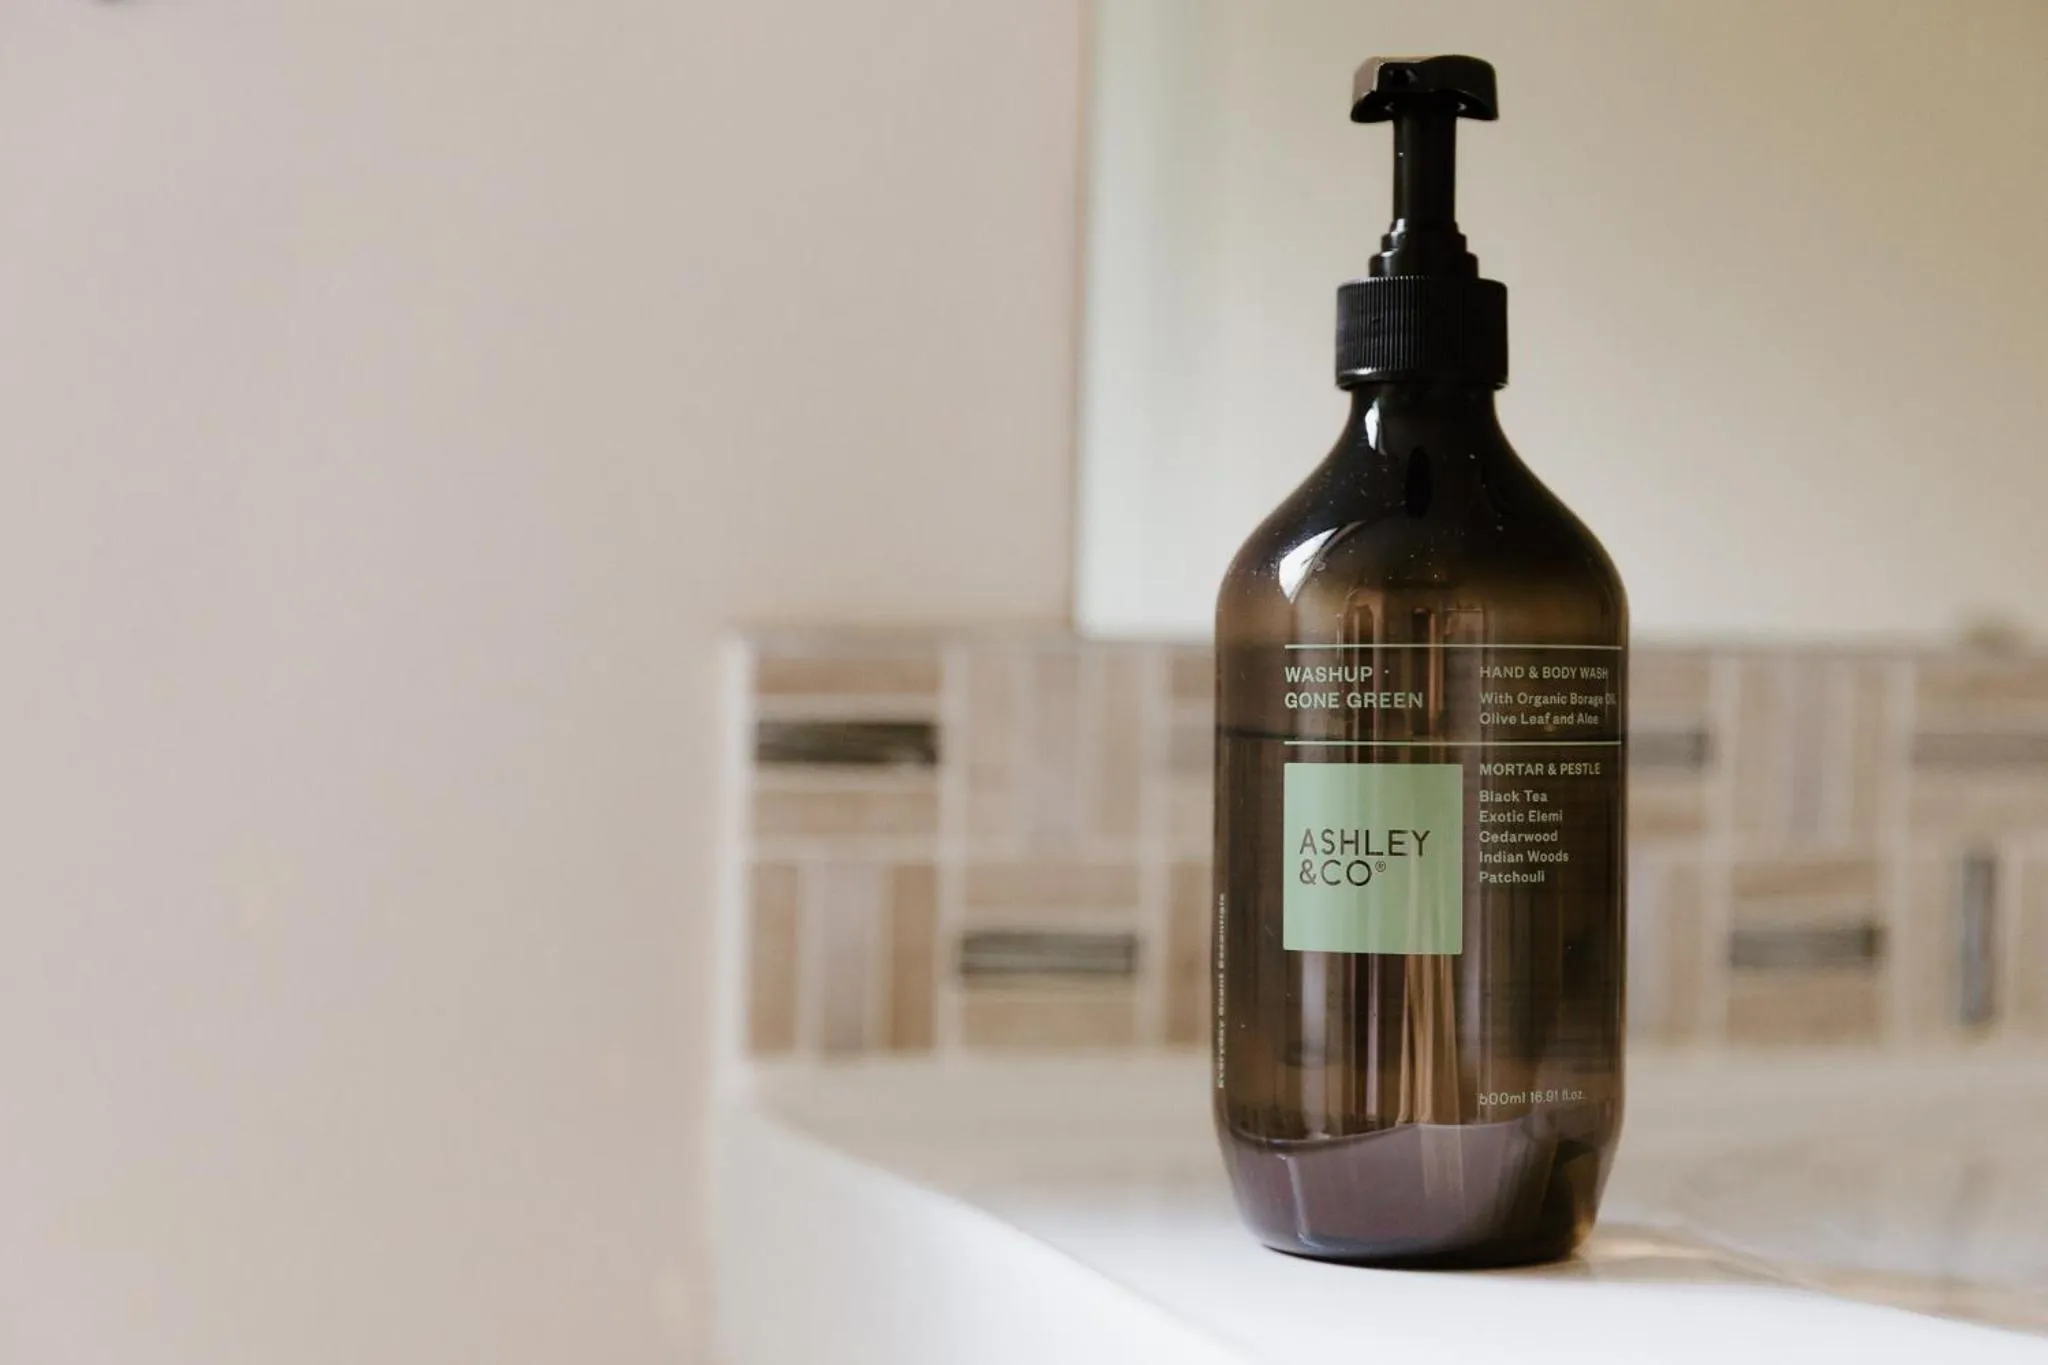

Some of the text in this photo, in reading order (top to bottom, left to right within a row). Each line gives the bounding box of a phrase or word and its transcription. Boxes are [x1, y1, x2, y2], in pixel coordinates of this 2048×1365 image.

[1284, 666, 1373, 683] WASHUP
[1479, 666, 1608, 680] HAND & BODY WASH
[1284, 692, 1424, 709] GONE GREEN
[1480, 692, 1513, 705] With
[1517, 692, 1567, 708] Organic
[1569, 693, 1603, 708] Borage
[1479, 712, 1599, 725] Olive Leaf and Aloe
[1479, 762, 1601, 776] MORTAR & PESTLE
[1479, 790, 1548, 803] Black Tea
[1479, 810, 1563, 823] Exotic Elemi
[1299, 828, 1431, 857] ASHLEY
[1479, 831, 1559, 844] Cedarwood
[1479, 850, 1570, 864] Indian Woods
[1479, 870, 1545, 884] Patchouli
[1479, 1091, 1525, 1106] 500ml
